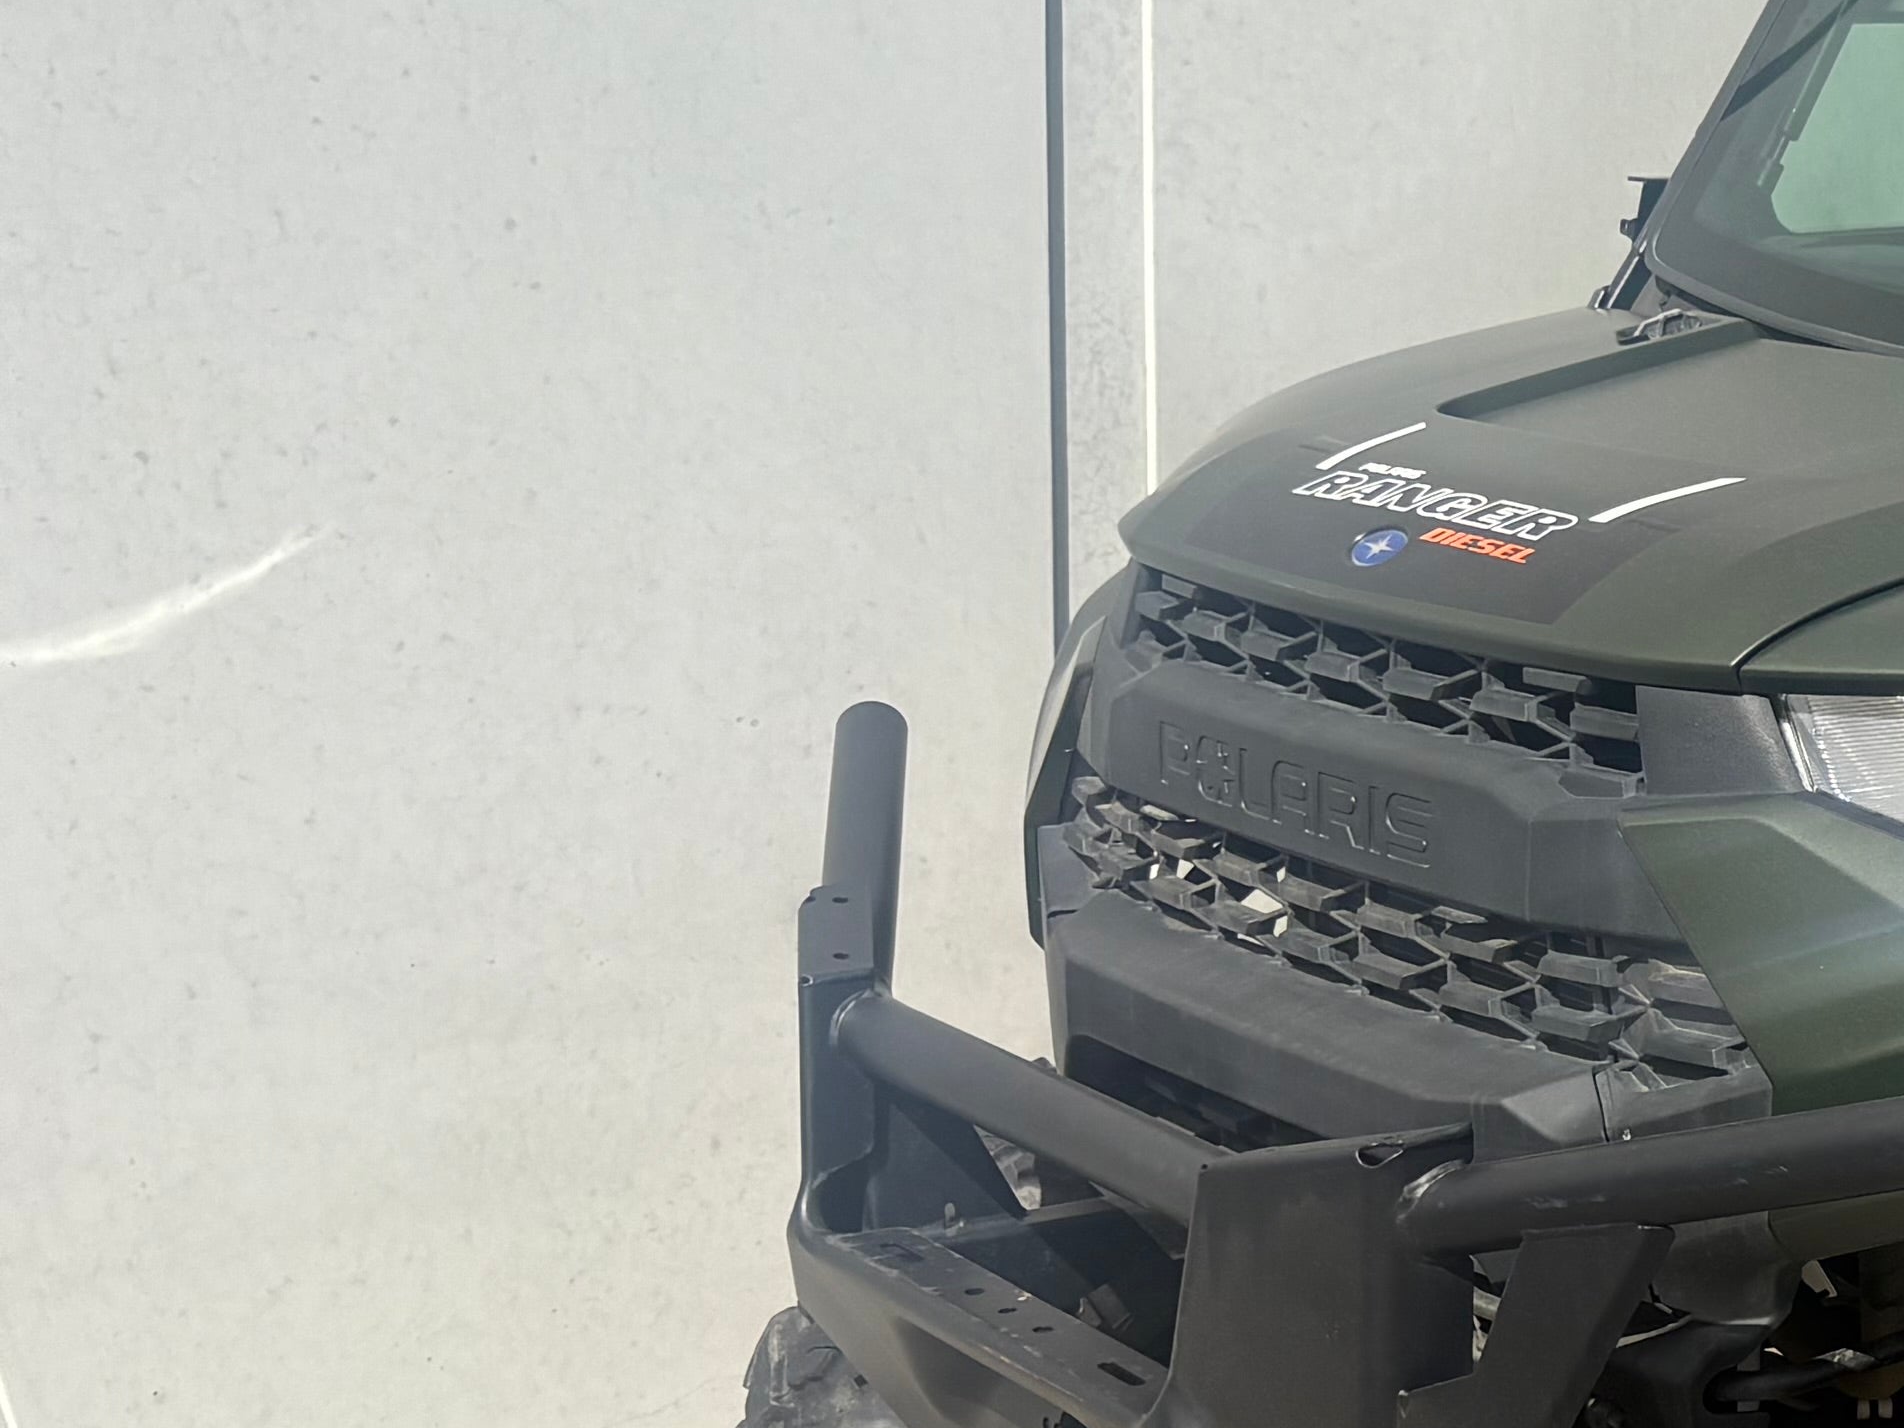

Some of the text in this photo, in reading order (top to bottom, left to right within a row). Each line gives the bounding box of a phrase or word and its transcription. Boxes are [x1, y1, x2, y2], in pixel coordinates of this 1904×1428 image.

[1291, 470, 1579, 541] RANGER
[1419, 526, 1536, 565] DIESEL
[1159, 719, 1434, 869] POLARIS
